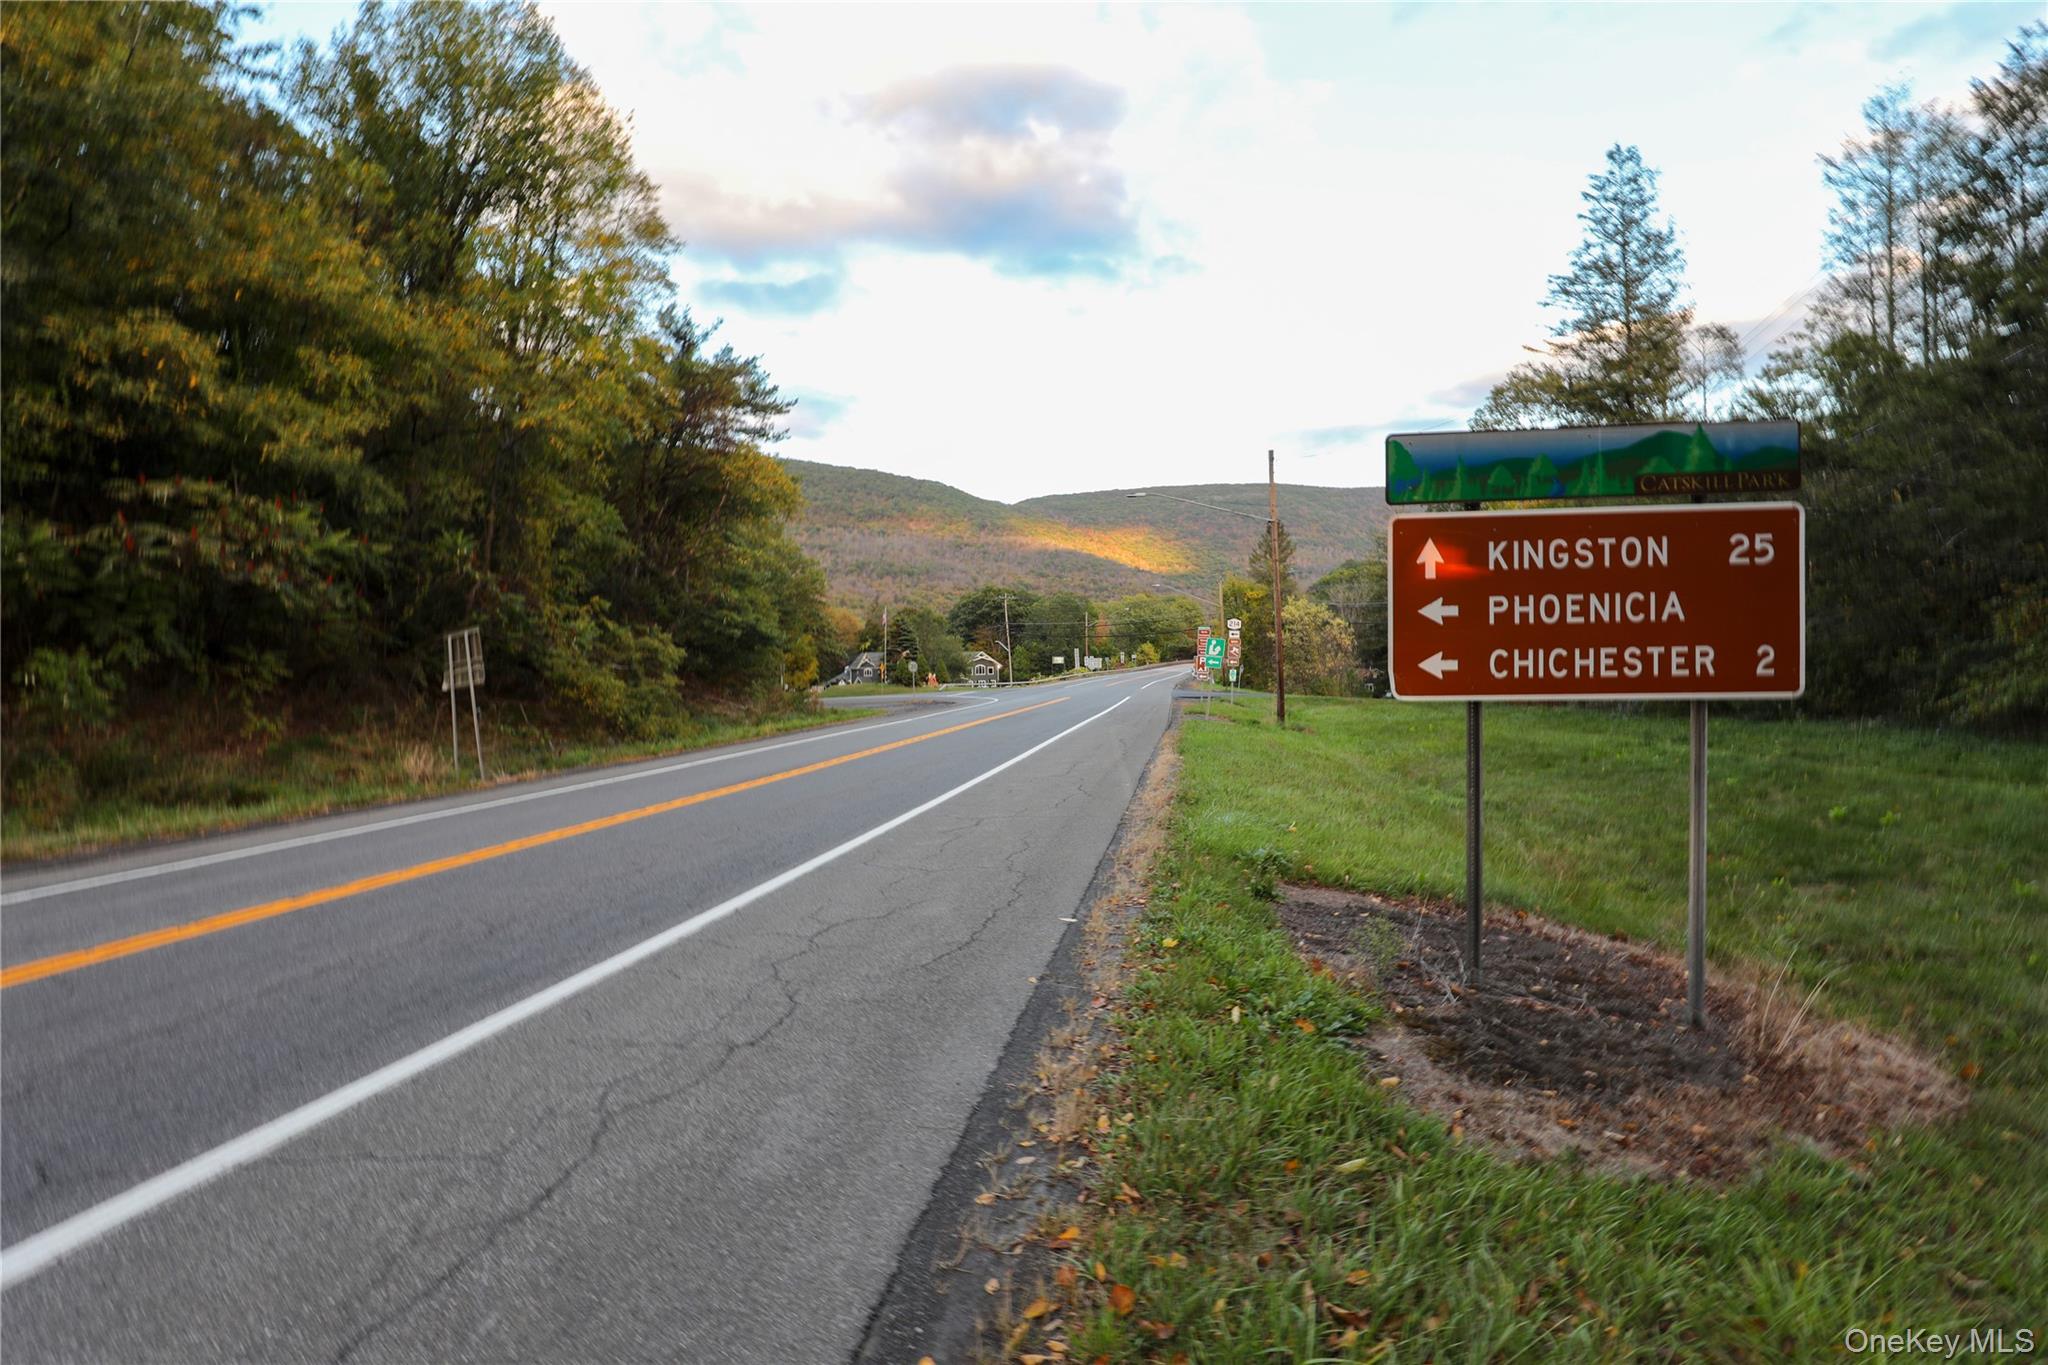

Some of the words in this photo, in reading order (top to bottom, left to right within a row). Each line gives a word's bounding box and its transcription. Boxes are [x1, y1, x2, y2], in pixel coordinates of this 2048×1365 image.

[1488, 535, 1669, 571] KINGSTON
[1728, 532, 1775, 567] 25
[1488, 591, 1686, 625] PHOENICIA
[1489, 645, 1716, 679] CHICHESTER
[1756, 644, 1775, 677] 2
